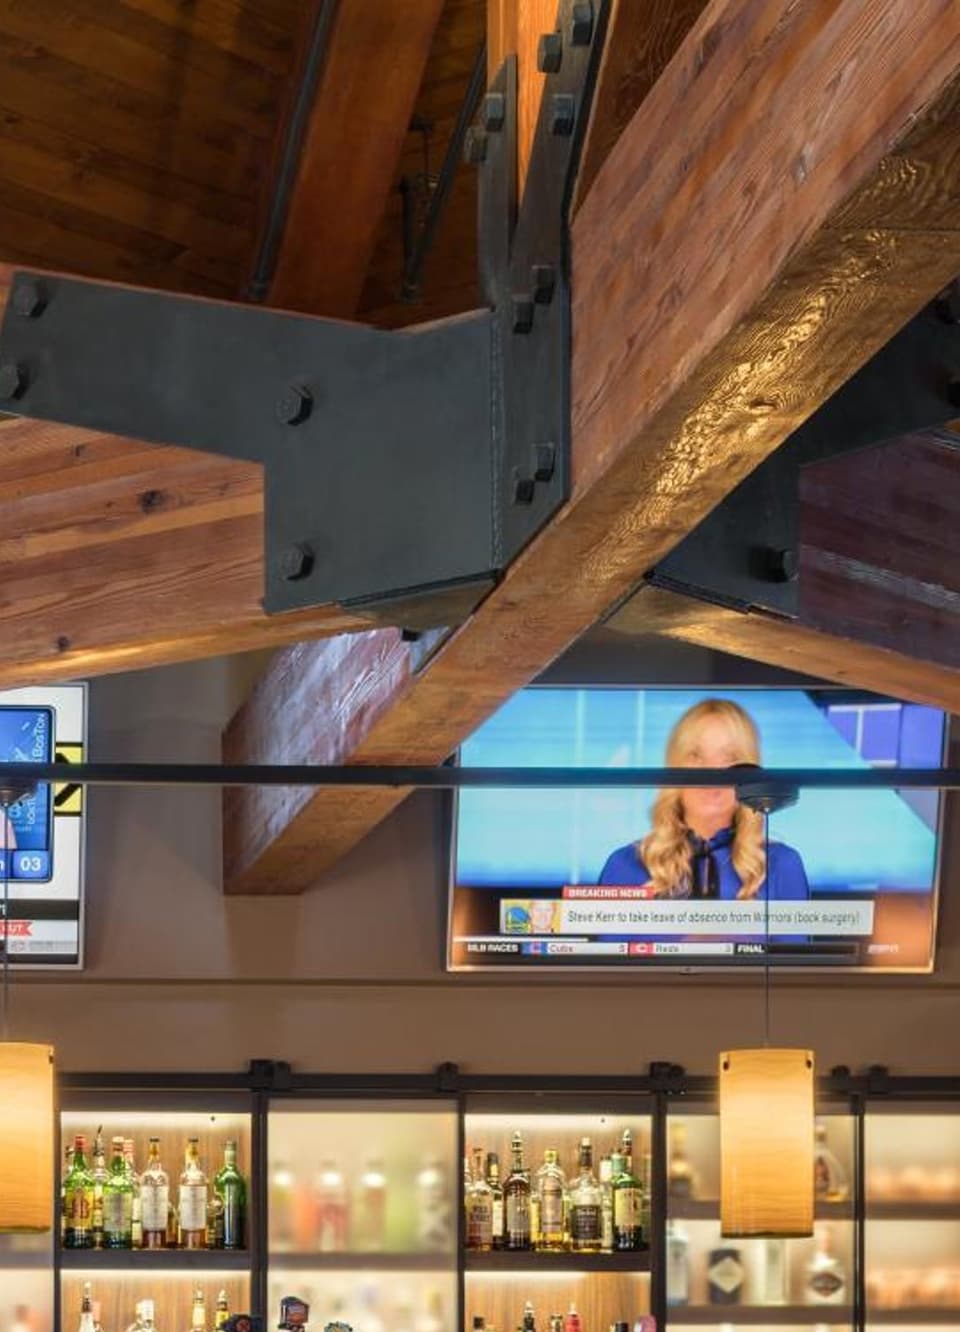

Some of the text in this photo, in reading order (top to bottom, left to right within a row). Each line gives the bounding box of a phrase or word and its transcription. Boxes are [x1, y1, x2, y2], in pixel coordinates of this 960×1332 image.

[20, 857, 42, 872] 03
[568, 889, 648, 898] BREAKING NEWS
[567, 911, 593, 922] Steve
[595, 911, 616, 922] Kerr
[617, 911, 626, 922] to
[628, 911, 648, 922] take
[650, 911, 675, 922] leave
[677, 911, 687, 922] of
[688, 911, 727, 922] absence
[729, 911, 752, 922] from
[737, 944, 765, 953] FINAL
